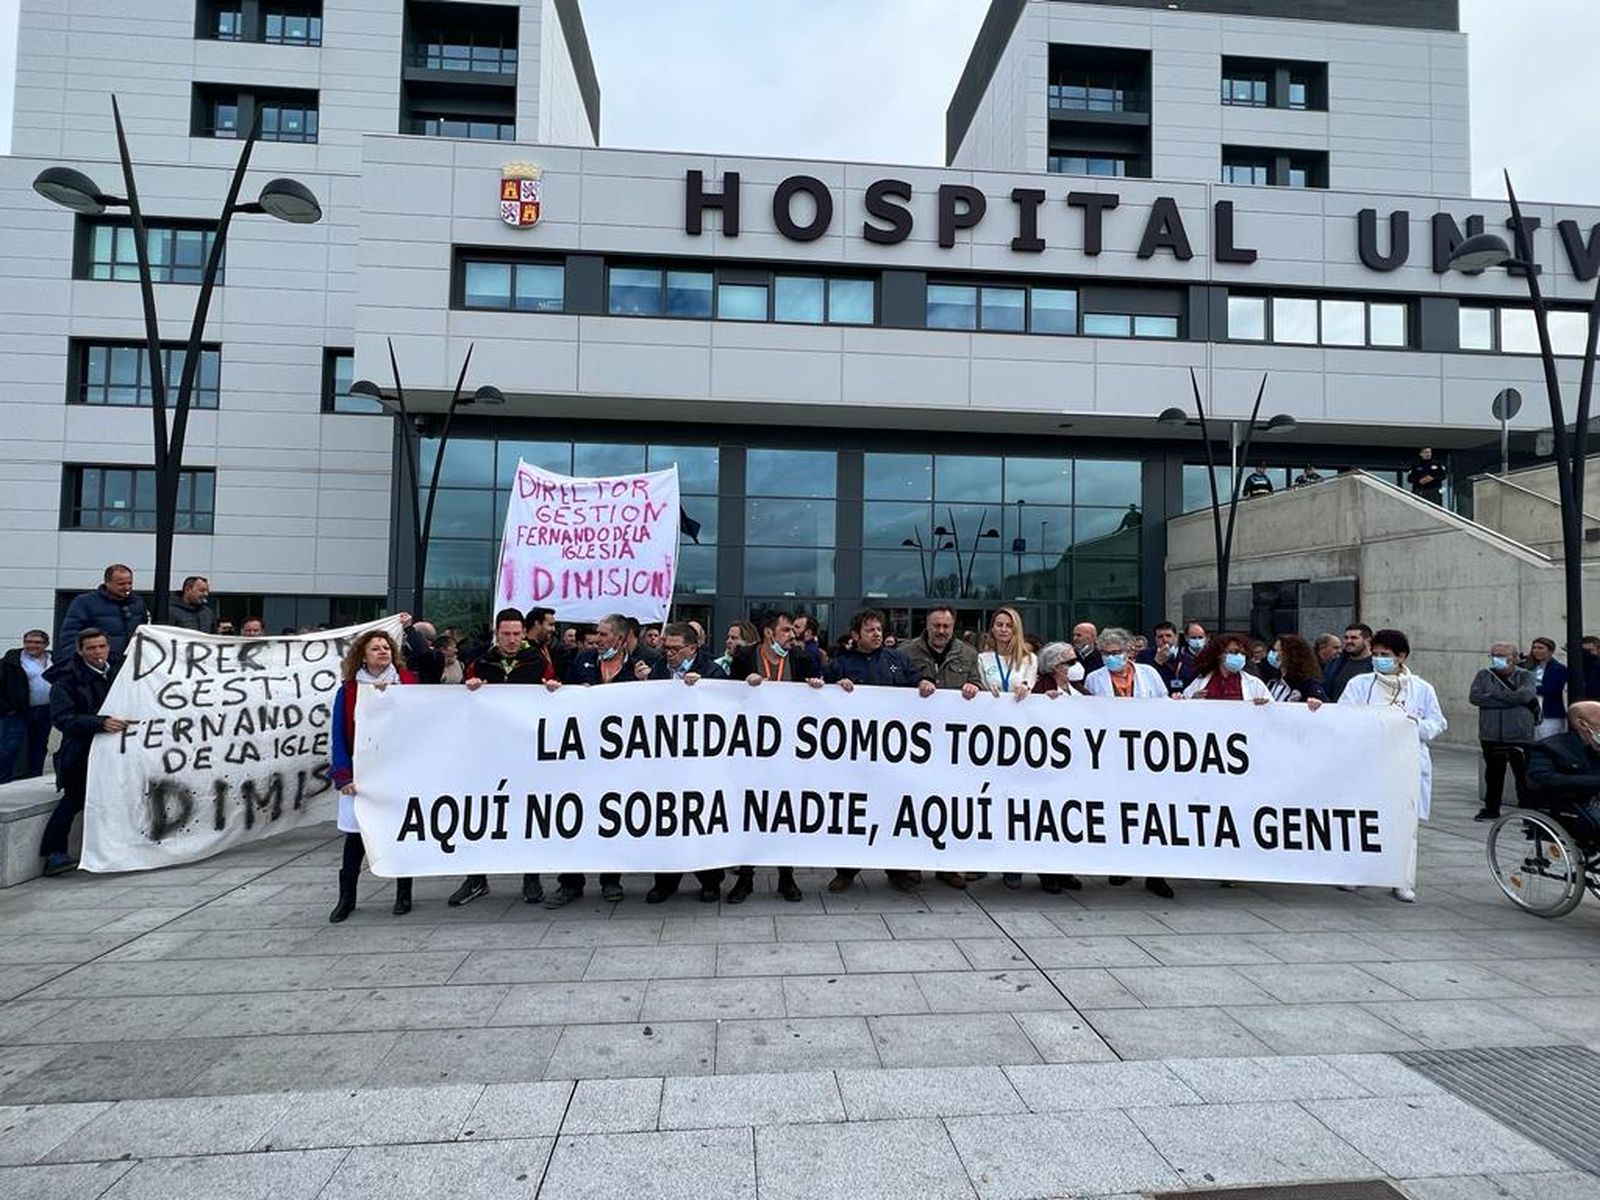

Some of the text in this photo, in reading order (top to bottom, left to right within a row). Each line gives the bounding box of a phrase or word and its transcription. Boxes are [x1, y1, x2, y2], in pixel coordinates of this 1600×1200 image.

[684, 170, 1258, 266] HOSPITAL
[535, 501, 668, 526] GESTION
[516, 525, 610, 547] FERNANDO
[561, 540, 636, 561] IGLESIA
[119, 703, 331, 754] FERNANDO
[537, 712, 1249, 775] LA SANIDAD SOMOS TODOS Y TODAS
[162, 746, 213, 774] DE
[224, 741, 261, 764] LA
[396, 778, 1382, 854] AQUÍ NO SOBRA NADIE, AQUÍ HACE FALTA GENTE
